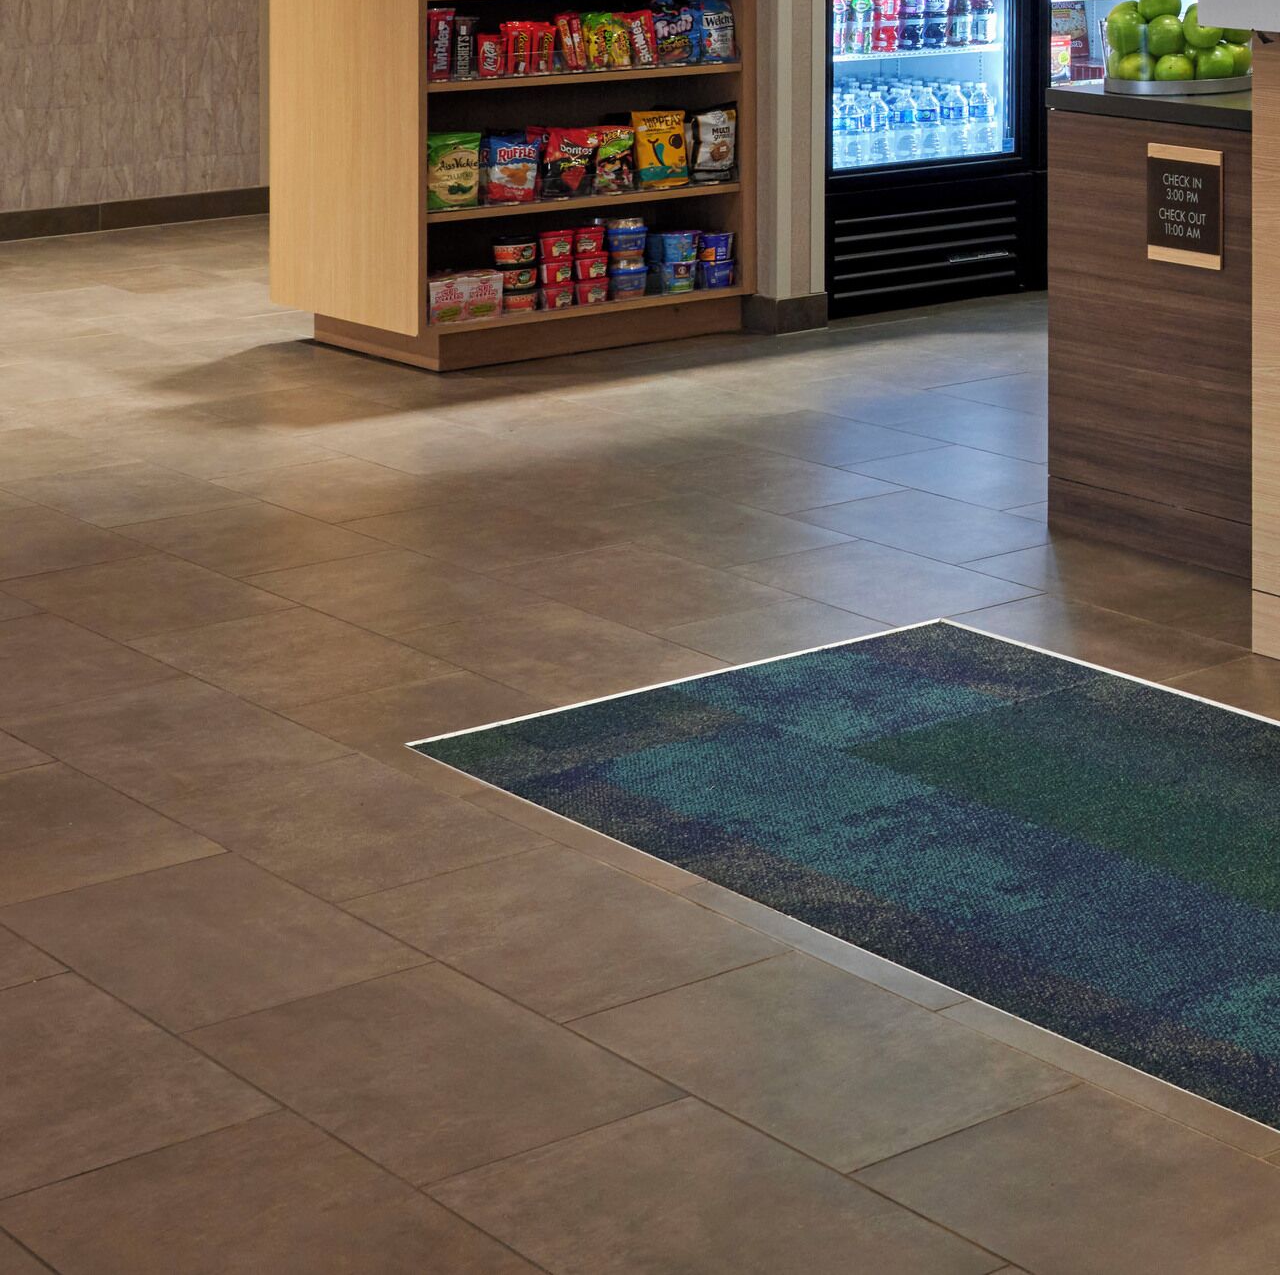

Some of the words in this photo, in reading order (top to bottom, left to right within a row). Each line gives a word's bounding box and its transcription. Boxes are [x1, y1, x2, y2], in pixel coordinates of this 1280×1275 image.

[560, 144, 593, 155] Doritos
[1162, 173, 1190, 188] CHECK
[1192, 177, 1202, 189] IN
[1166, 188, 1184, 202] 3:00
[1186, 191, 1199, 203] PM
[1158, 208, 1186, 223] CHECK
[1188, 212, 1206, 225] OUT
[1164, 223, 1184, 237] 11:00
[1186, 228, 1201, 239] AM
